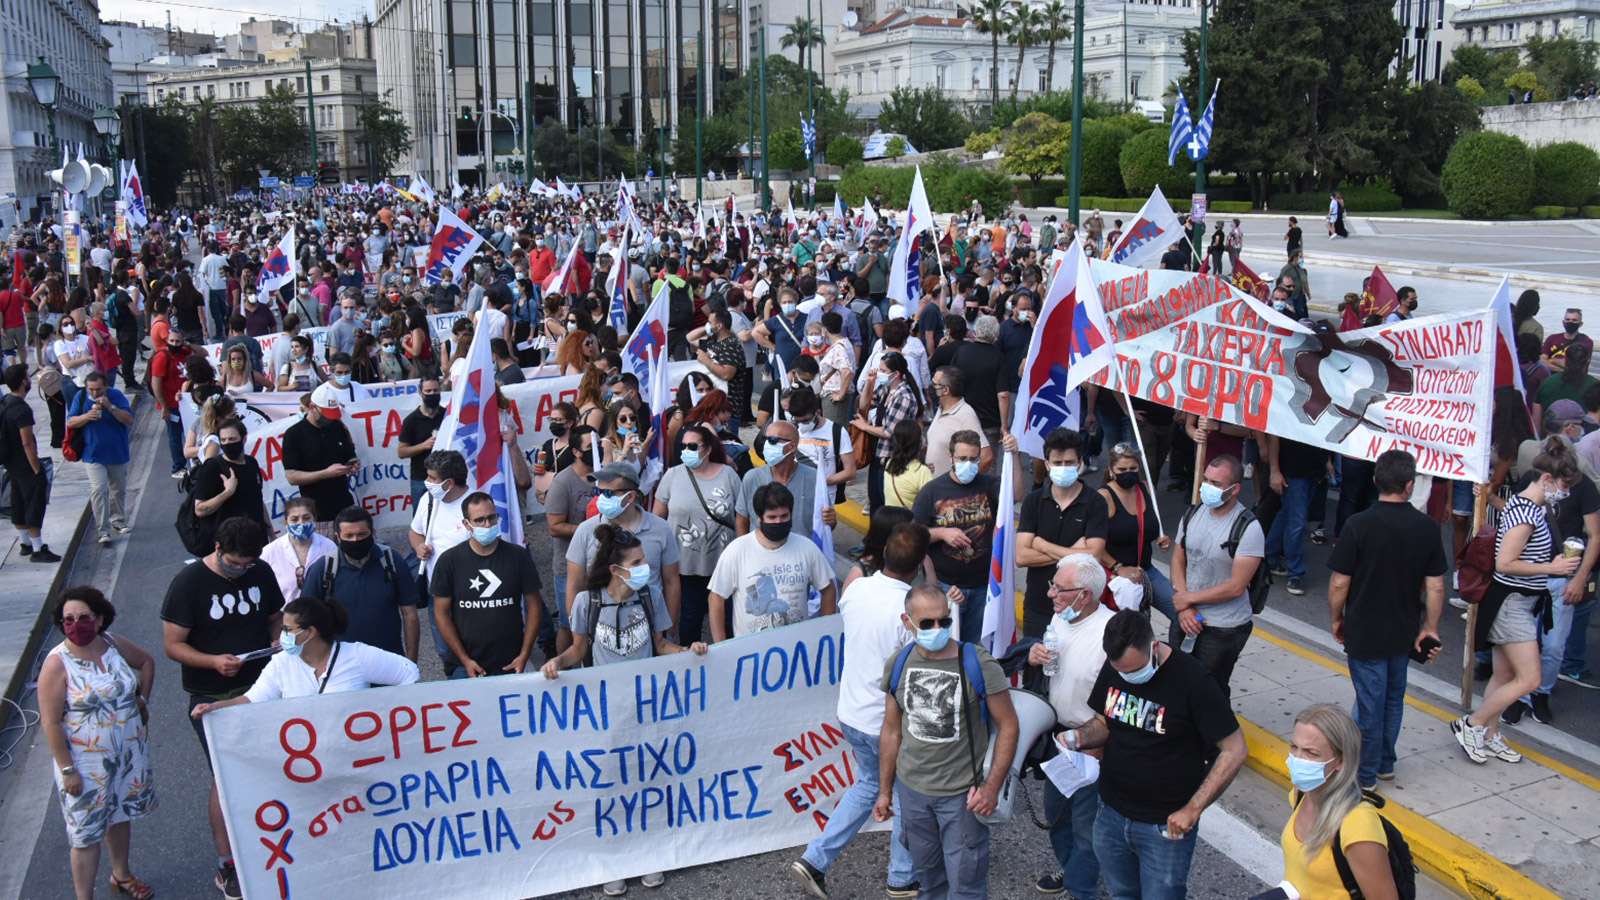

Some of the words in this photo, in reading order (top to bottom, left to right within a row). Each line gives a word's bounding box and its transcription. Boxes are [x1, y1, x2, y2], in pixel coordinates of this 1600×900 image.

[1379, 320, 1483, 361] ΣΥΝΔΙΚΑΤΟ
[1384, 396, 1476, 423] ΕΠΙΣΙΤΙΣΜΟΥ
[1384, 416, 1477, 448] ΞΕΝΟΔΟΧΕΙΩΝ
[773, 562, 792, 574] Isle
[774, 574, 806, 586] Wight
[459, 597, 514, 609] CONVERSE
[279, 718, 323, 783] 8
[344, 700, 478, 768] ΩΡΕΣ
[498, 680, 609, 738] ΕΙΝΑΙ
[635, 665, 706, 724] ΗΔΗ
[1104, 686, 1167, 735] MARVEL
[308, 795, 366, 838] στα
[366, 756, 511, 816] ΩΡΑΡΙΑ
[535, 731, 697, 792] ΛΑΣΤΙΧΟ
[372, 807, 521, 872] ΔΟΥΛΕΙΑ
[595, 764, 772, 838] ΚΥΡΙΑΚΕΣ
